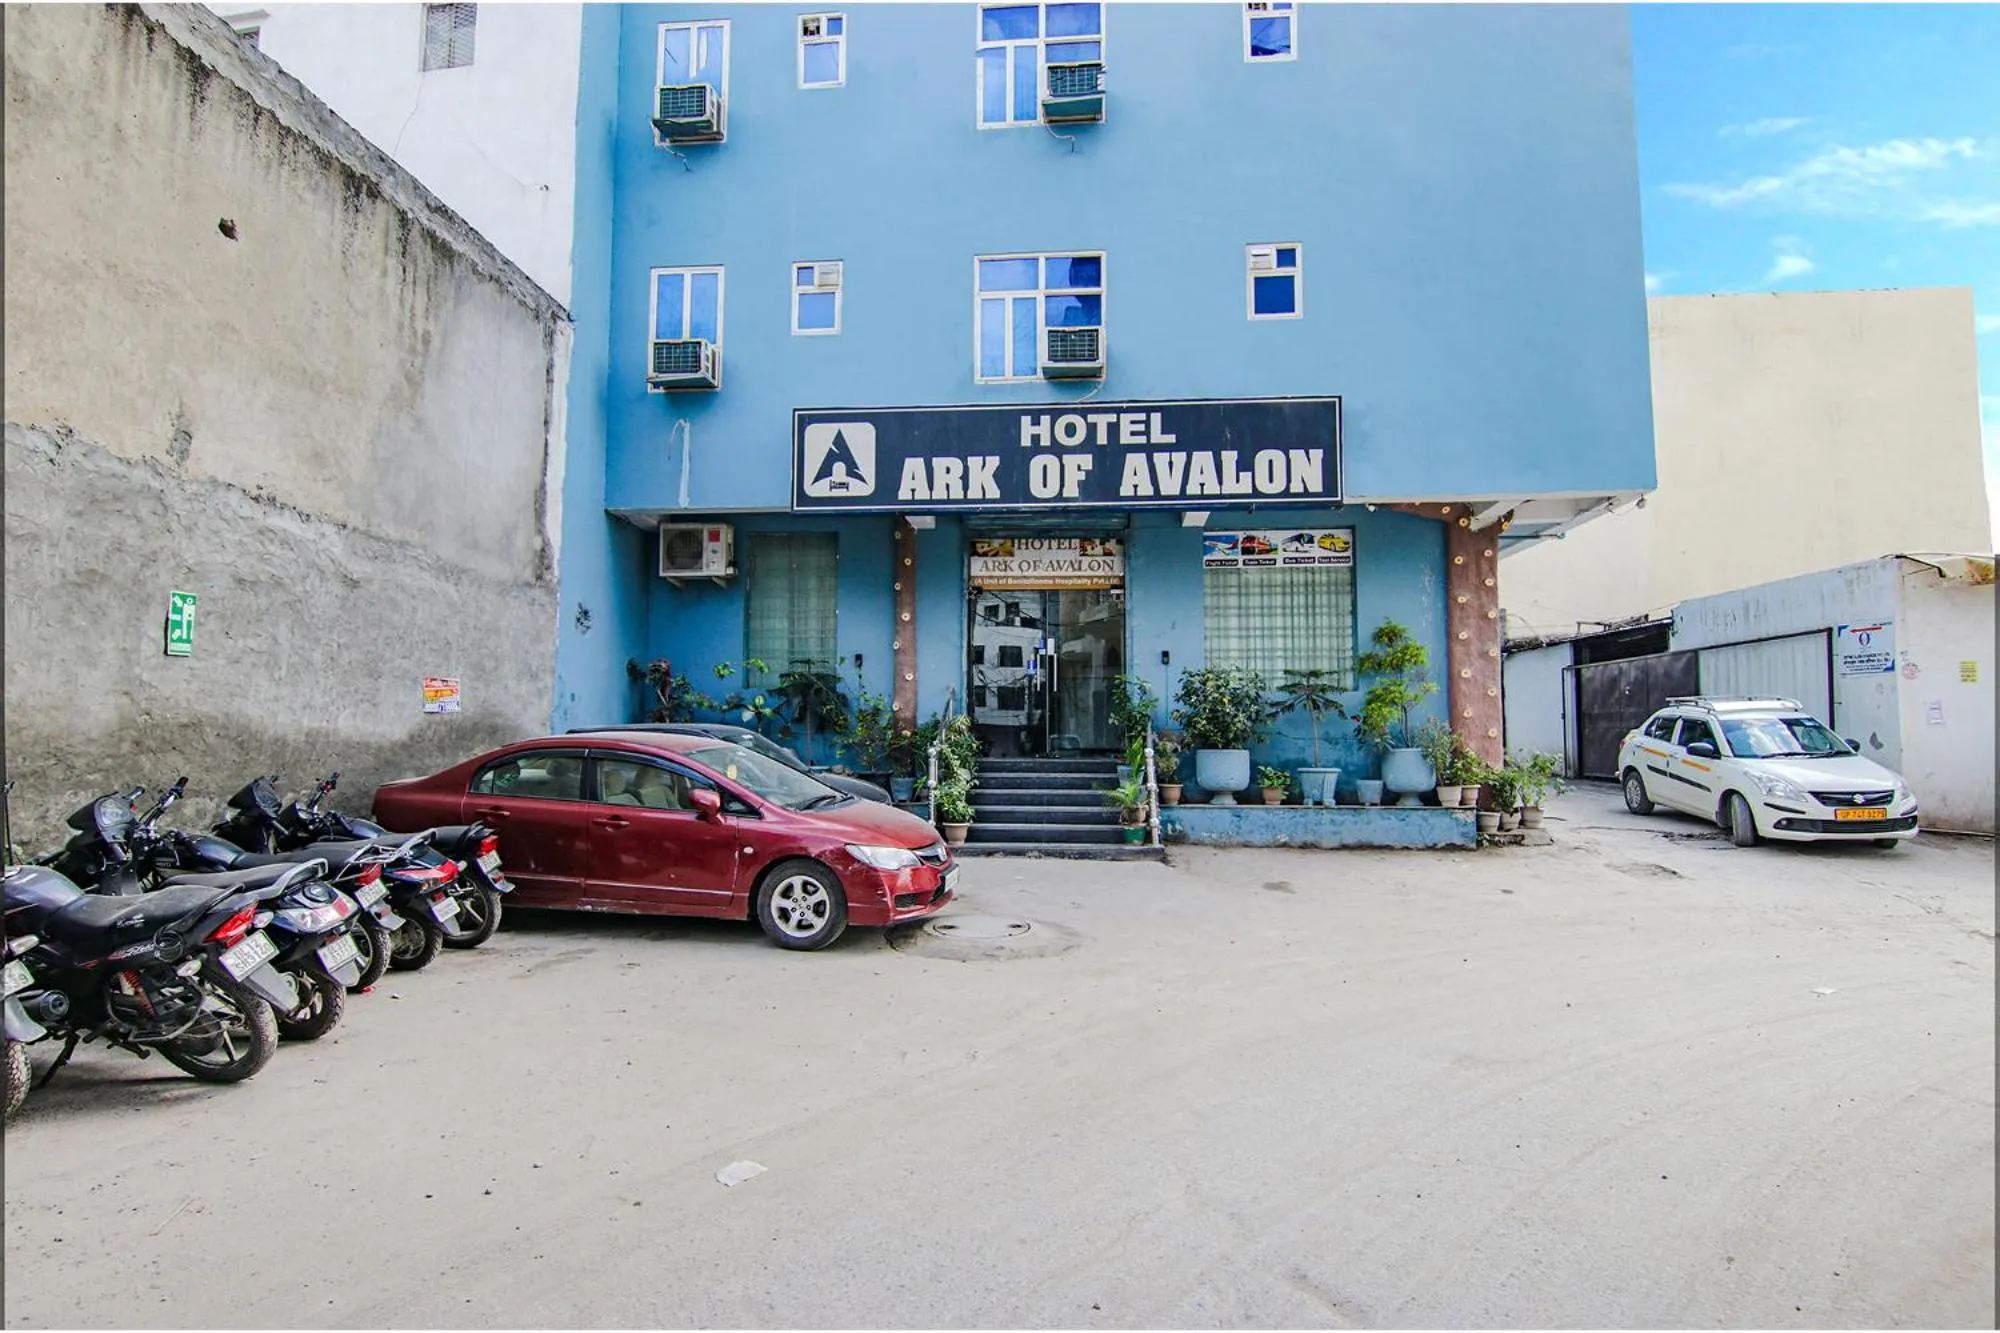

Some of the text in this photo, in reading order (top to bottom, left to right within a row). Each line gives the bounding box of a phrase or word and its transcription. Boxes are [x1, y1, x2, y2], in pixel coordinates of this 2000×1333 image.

[1020, 412, 1177, 447] HOTEL
[898, 448, 1324, 500] ARK OF AVALON
[1016, 538, 1078, 550] HOTEL
[979, 558, 1114, 574] ARK OF AVALON
